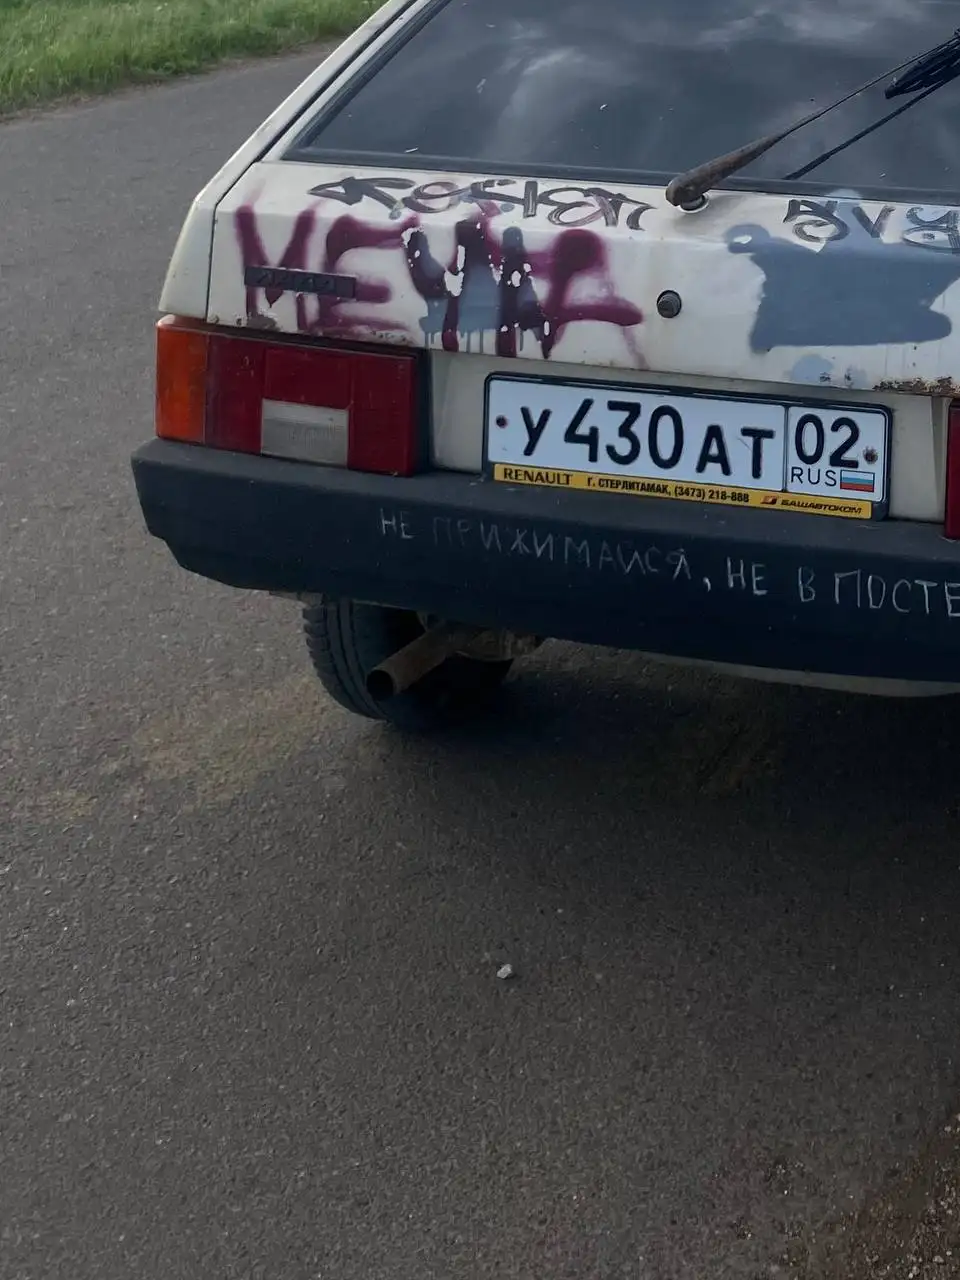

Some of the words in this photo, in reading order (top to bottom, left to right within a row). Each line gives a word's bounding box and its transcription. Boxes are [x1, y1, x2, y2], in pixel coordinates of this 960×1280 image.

[795, 414, 860, 468] 02
[503, 467, 573, 486] RENAULT
[791, 466, 837, 487] RUS
[598, 478, 671, 497] СТЕРЛИТАМАК,
[379, 508, 413, 540] НЕ
[727, 557, 768, 595] НЕ
[799, 567, 816, 602] В
